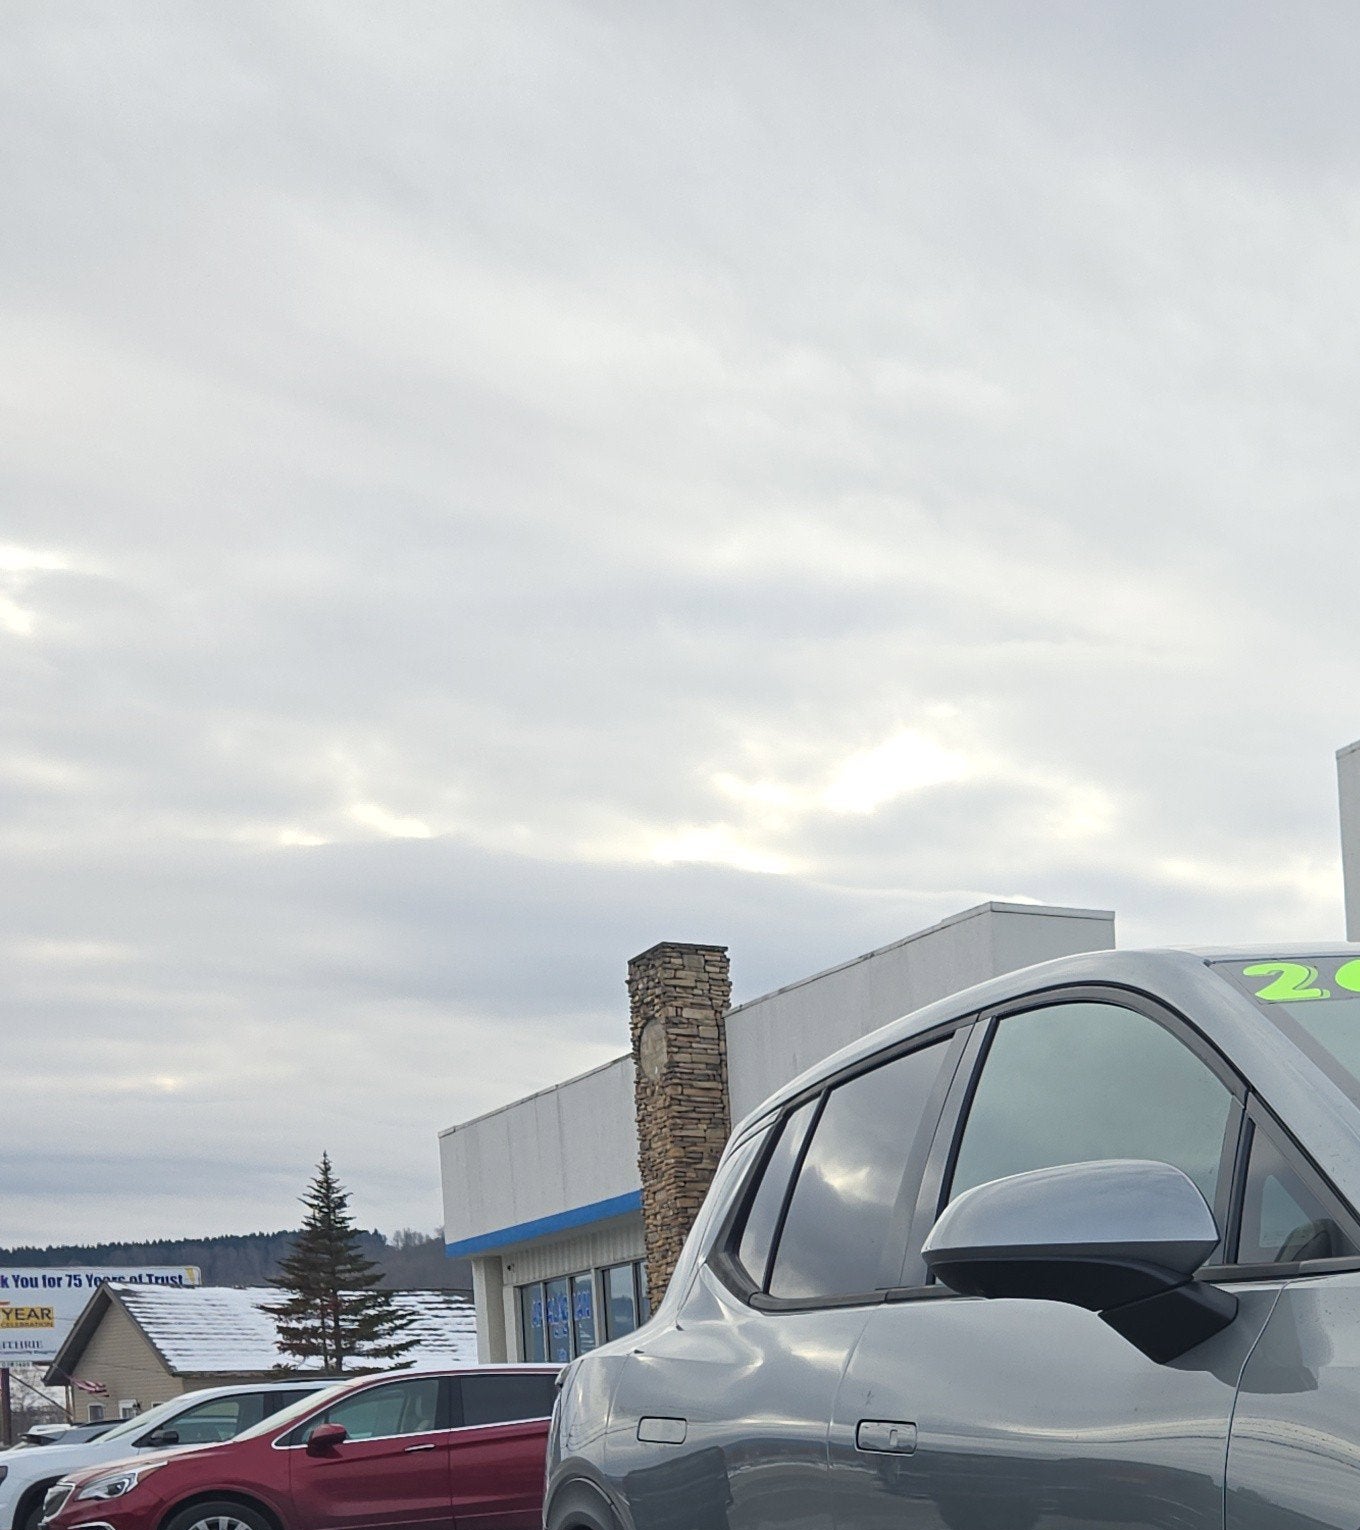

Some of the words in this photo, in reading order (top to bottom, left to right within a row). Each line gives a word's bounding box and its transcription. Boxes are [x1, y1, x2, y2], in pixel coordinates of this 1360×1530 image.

[11, 1274, 39, 1289] You
[42, 1274, 62, 1289] for
[65, 1273, 83, 1289] 75
[146, 1273, 184, 1286] Trust
[1, 1307, 52, 1321] YEAR
